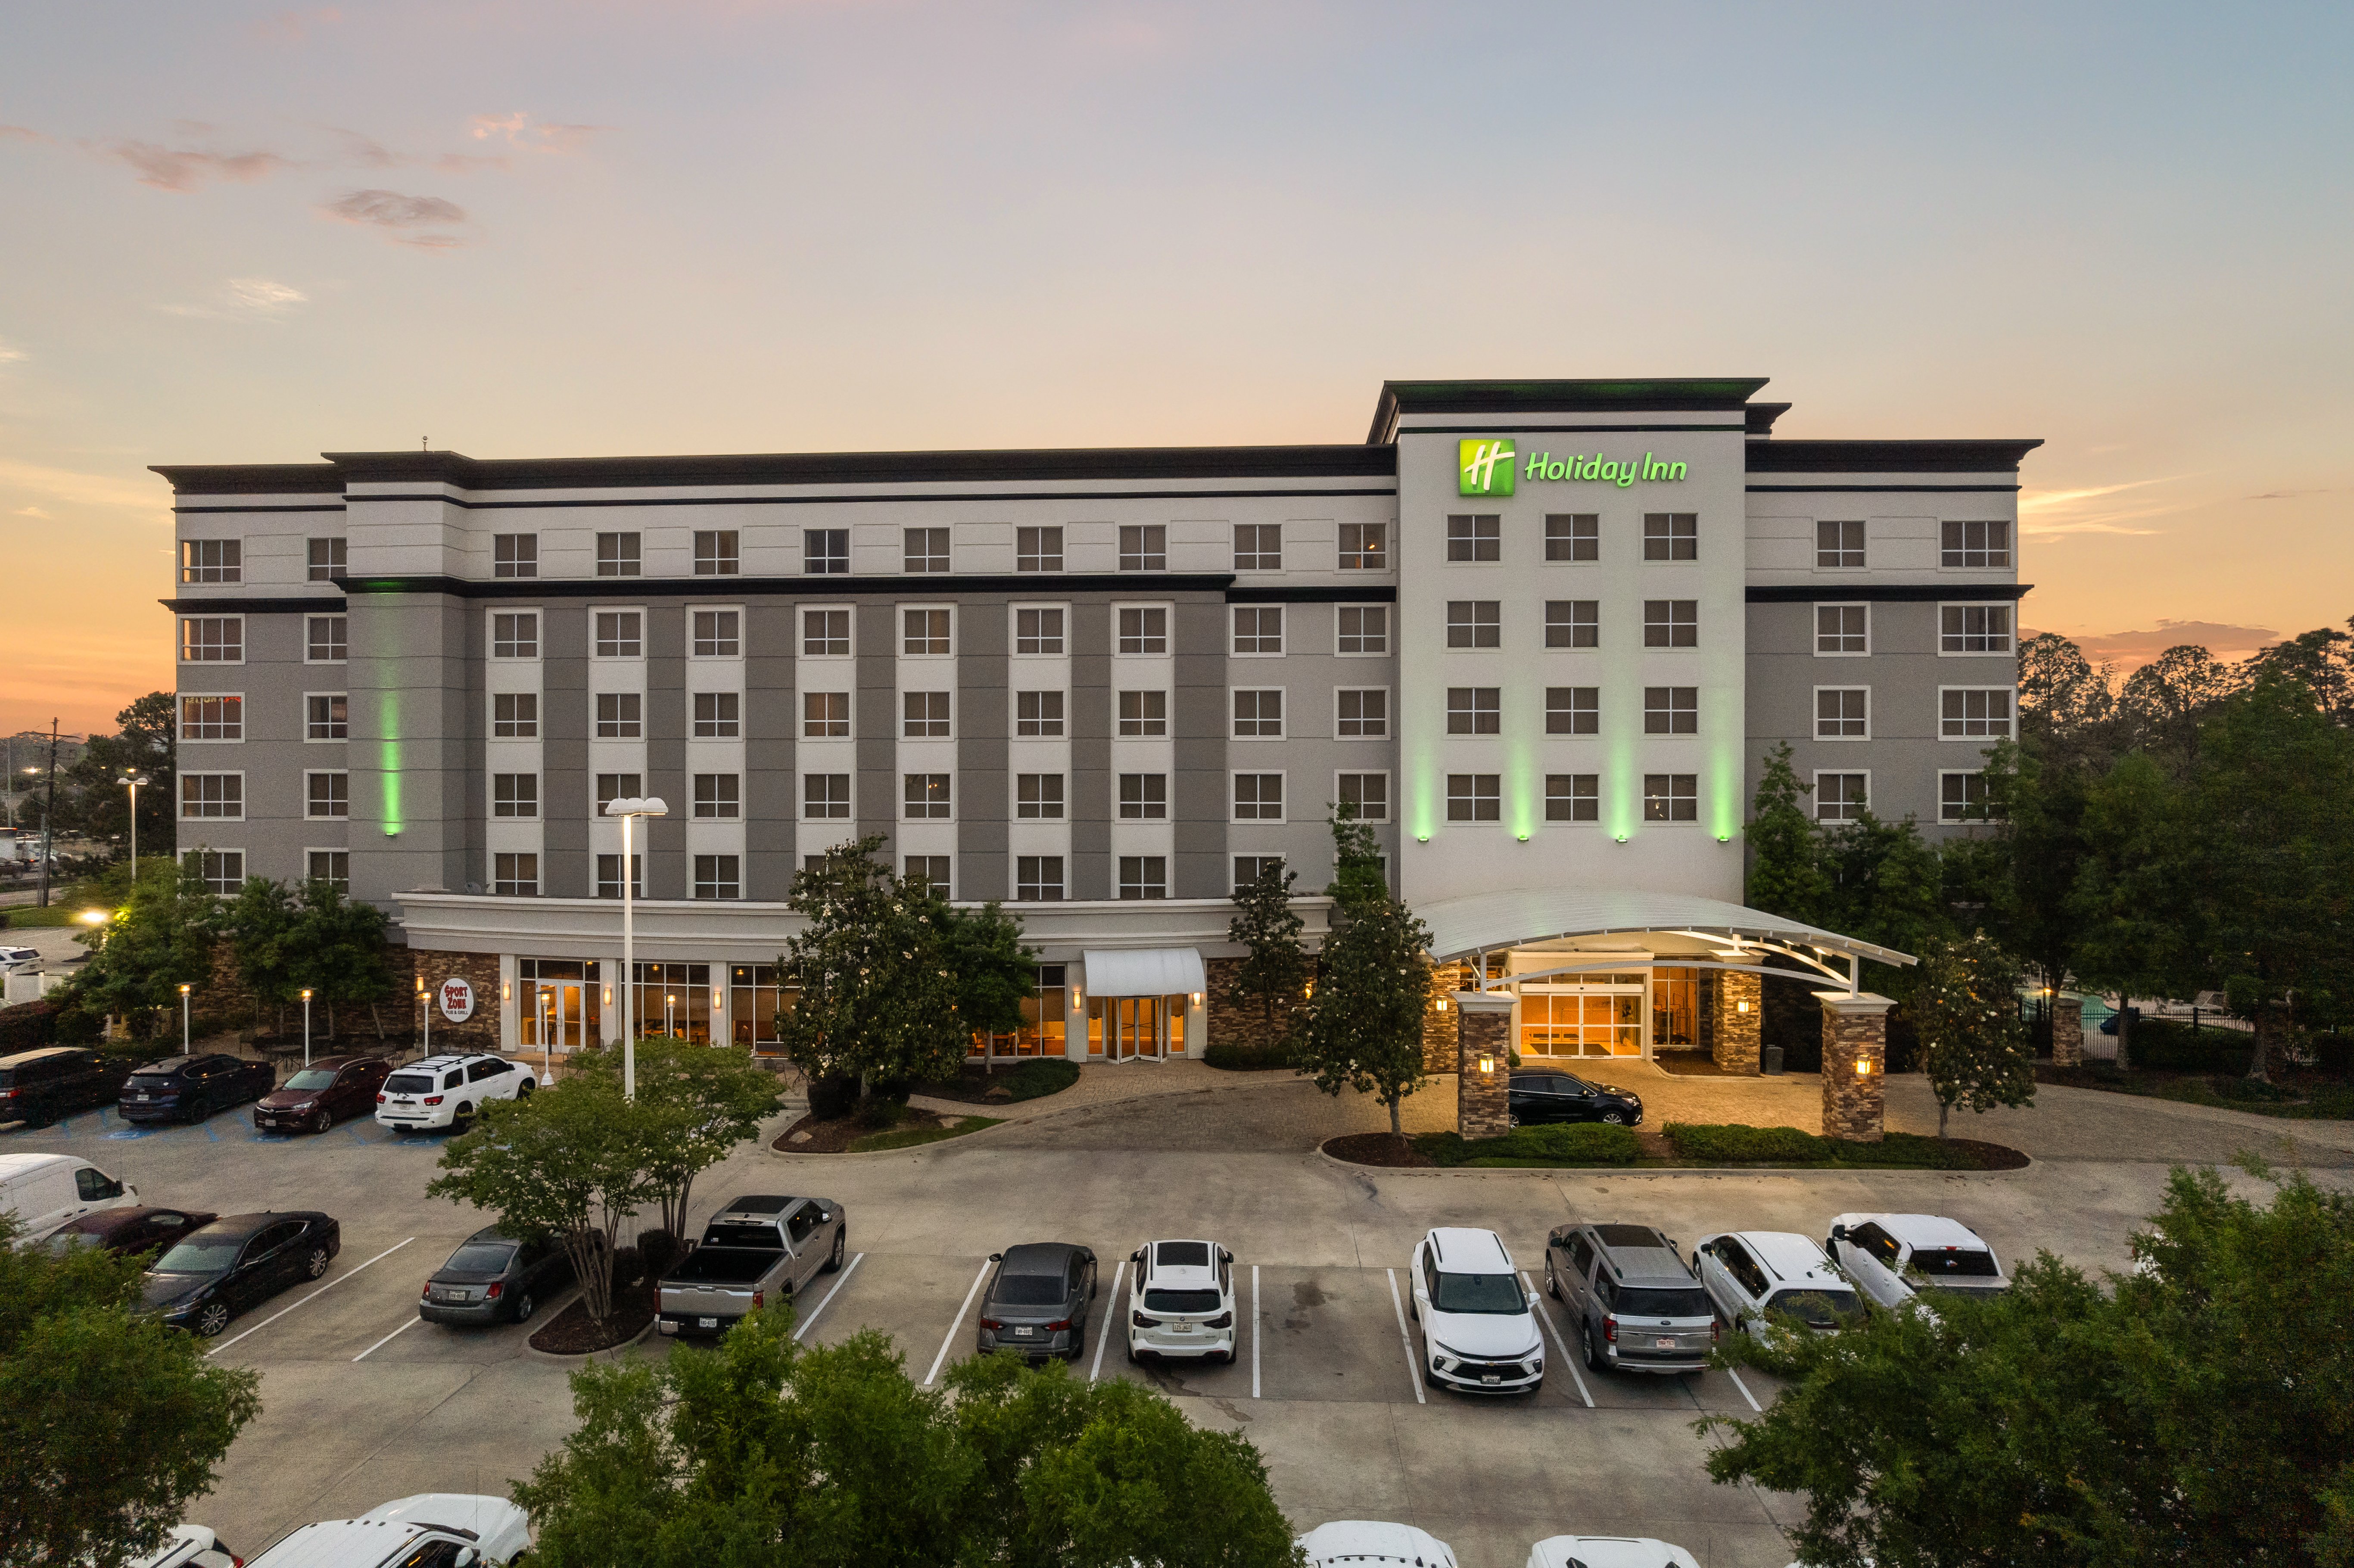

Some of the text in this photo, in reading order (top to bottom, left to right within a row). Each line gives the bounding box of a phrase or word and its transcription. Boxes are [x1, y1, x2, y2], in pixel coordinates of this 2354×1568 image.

[1525, 452, 1687, 487] Holiday Inn
[445, 984, 468, 997] SPORT
[447, 997, 467, 1009] ZONE
